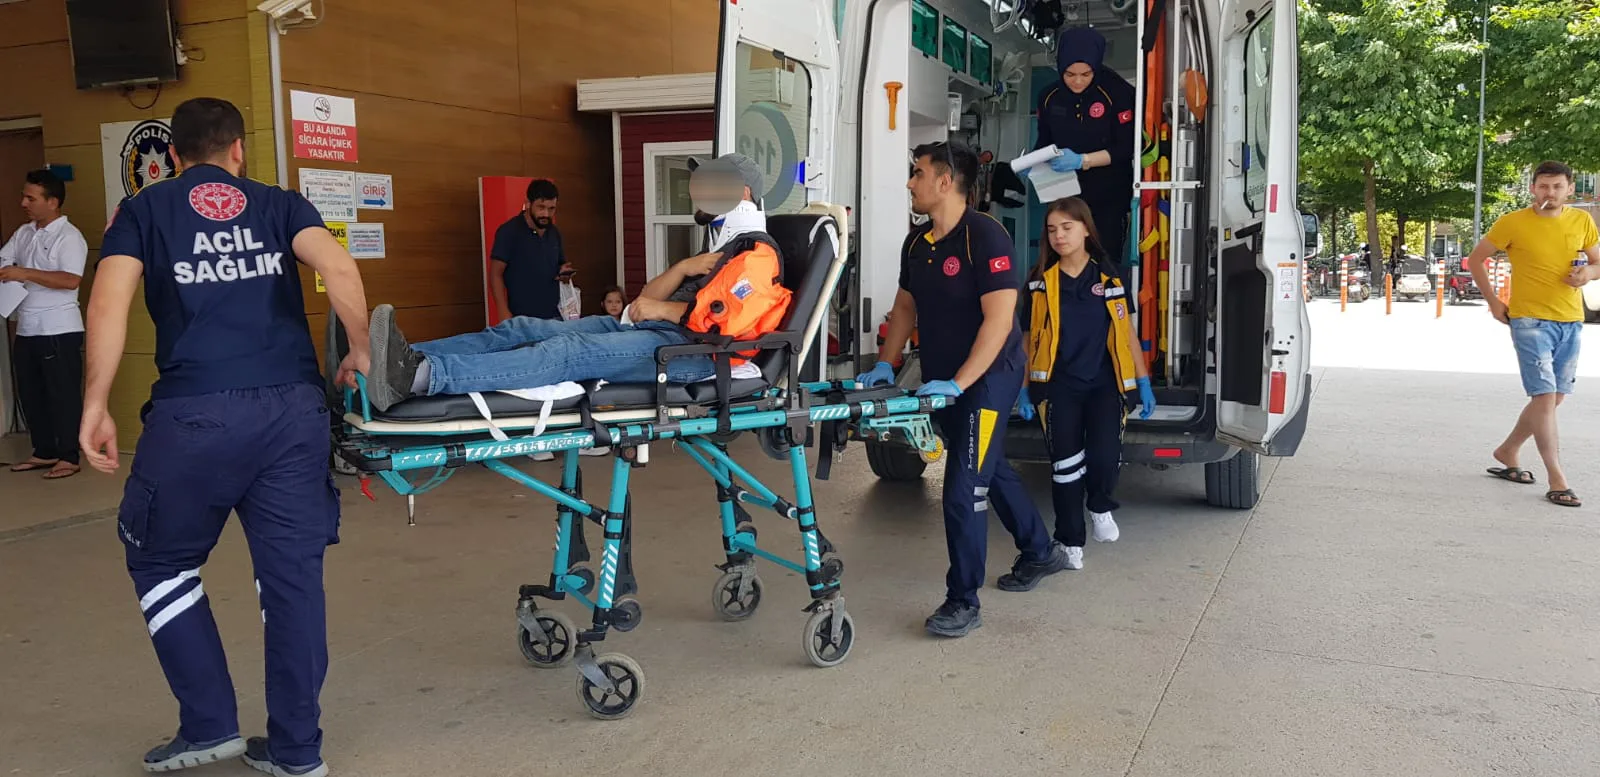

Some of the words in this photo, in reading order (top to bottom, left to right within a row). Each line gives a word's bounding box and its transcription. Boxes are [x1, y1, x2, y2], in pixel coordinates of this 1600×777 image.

[134, 128, 169, 145] POLİS
[303, 123, 315, 133] BU
[316, 125, 347, 137] ALANDA
[298, 133, 328, 147] SİGARA
[328, 136, 352, 149] İÇMEK
[307, 148, 345, 160] YASAKTIR
[362, 183, 386, 198] GİRİŞ
[192, 224, 264, 255] ACİL
[173, 252, 284, 284] SAĞLIK
